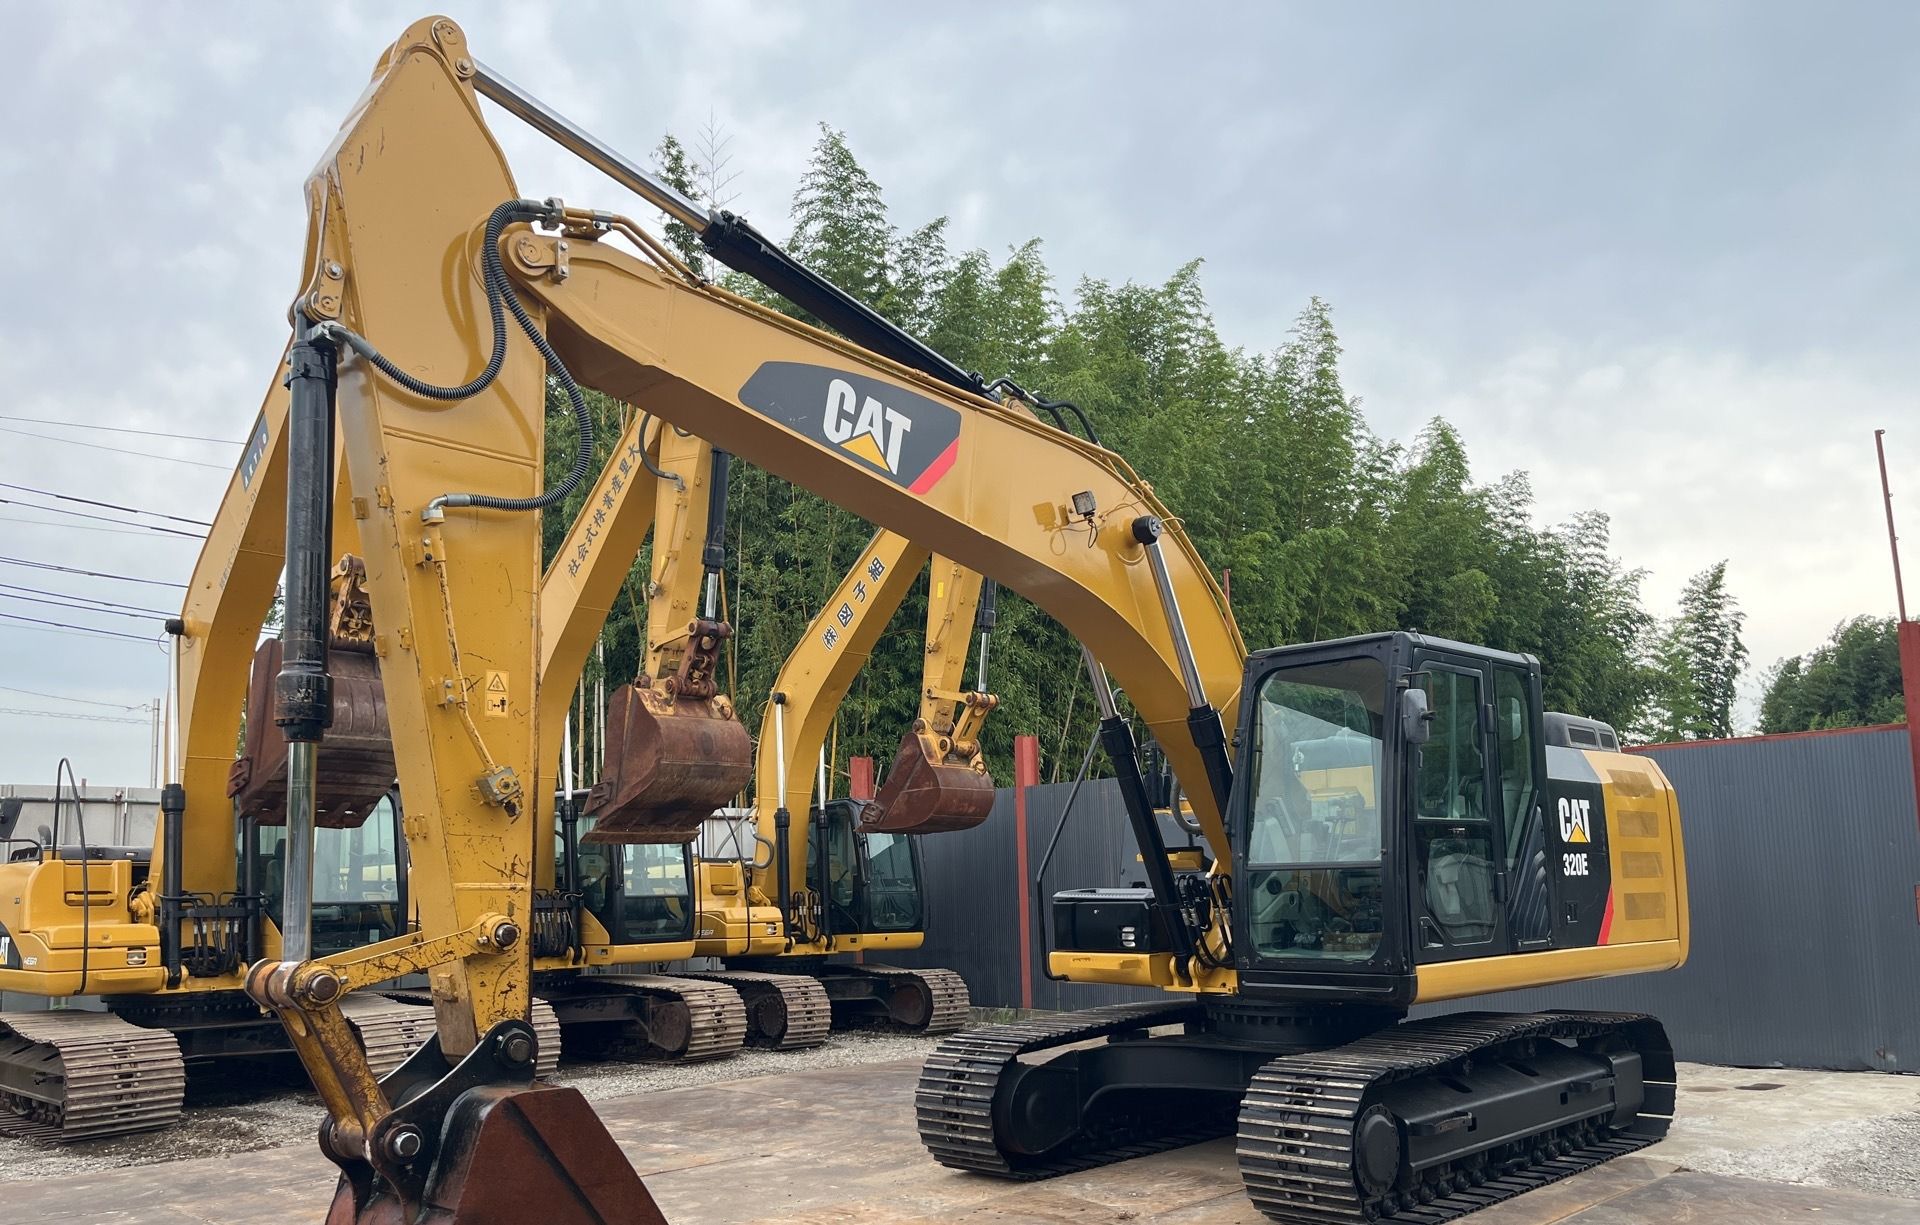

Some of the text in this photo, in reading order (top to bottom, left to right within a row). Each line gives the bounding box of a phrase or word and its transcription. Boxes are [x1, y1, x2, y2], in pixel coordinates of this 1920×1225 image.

[823, 378, 912, 475] CAT
[1558, 797, 1591, 843] CAT
[1563, 853, 1589, 876] 320E
[0, 936, 11, 966] AT
